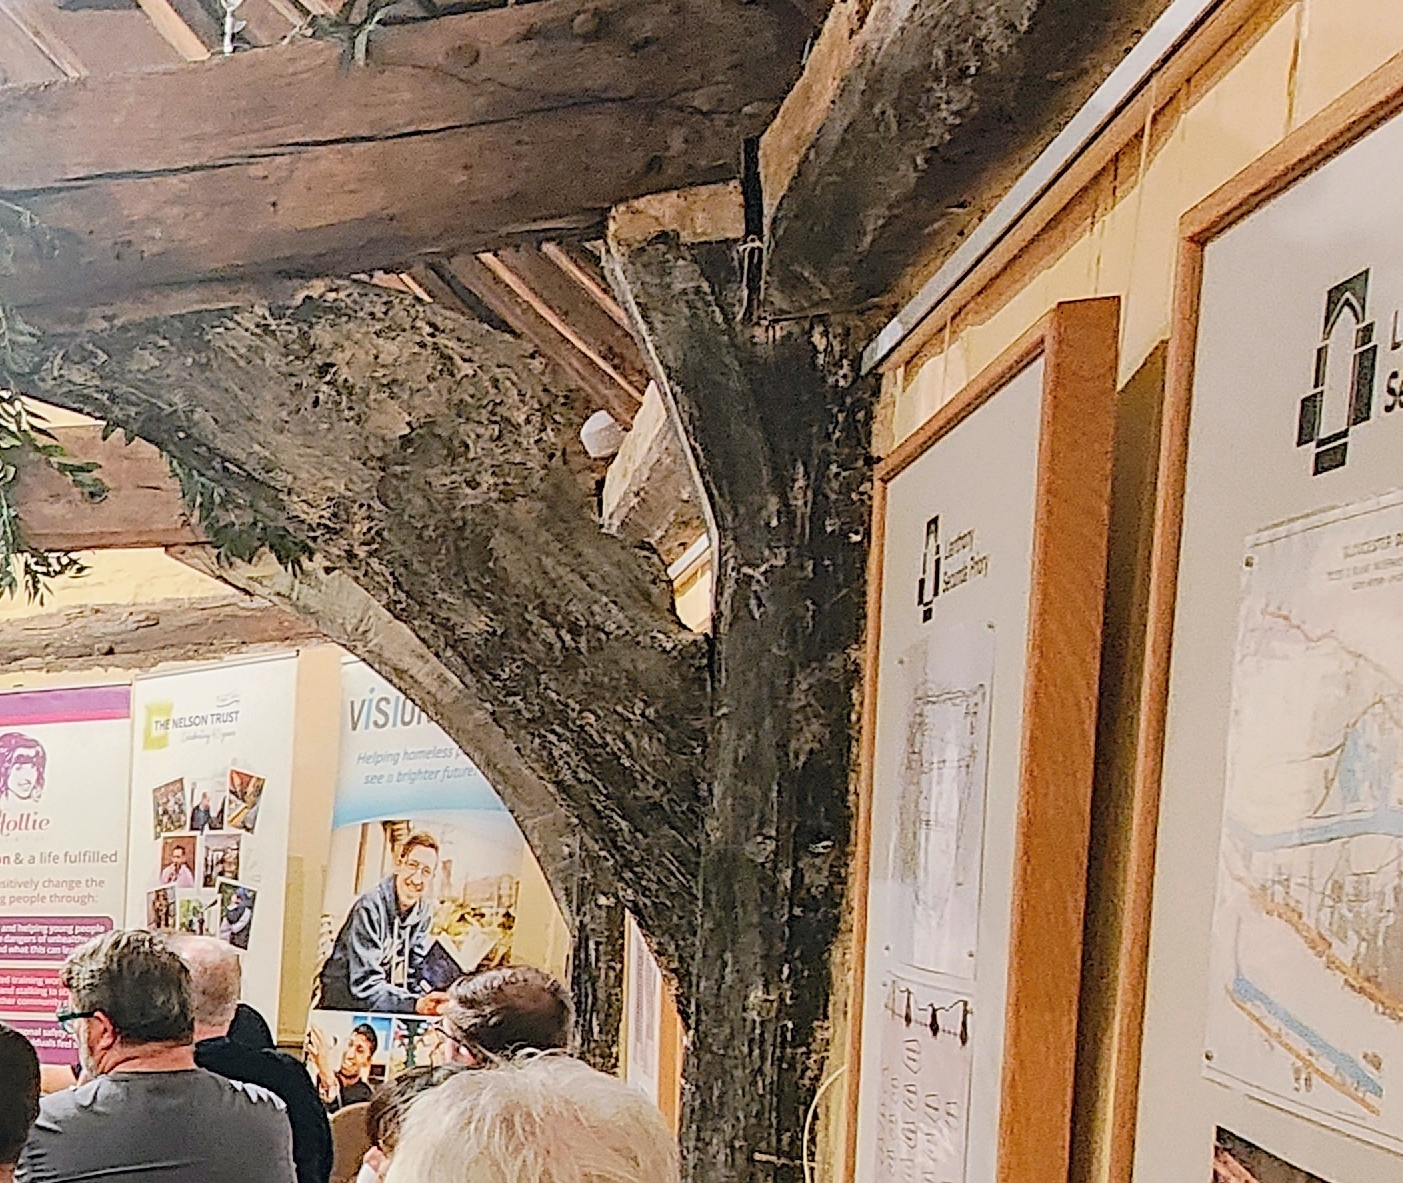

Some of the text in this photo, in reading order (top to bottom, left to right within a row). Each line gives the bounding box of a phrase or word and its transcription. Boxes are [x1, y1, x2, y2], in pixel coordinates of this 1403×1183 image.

[154, 710, 240, 731] THE NELSON TRUST
[356, 750, 400, 766] Helping
[402, 746, 454, 762] homeless
[363, 773, 385, 785] see
[386, 773, 394, 783] a
[396, 767, 441, 785] brighter
[13, 852, 24, 865] &
[27, 854, 36, 865] a
[39, 851, 60, 865] life
[63, 850, 118, 864] fulfilled
[42, 877, 82, 890] change
[85, 876, 105, 888] the
[9, 893, 46, 905] people
[49, 892, 99, 905] through:
[1, 923, 16, 933] and
[18, 923, 48, 935] helping
[49, 924, 74, 935] young
[75, 923, 106, 934] people
